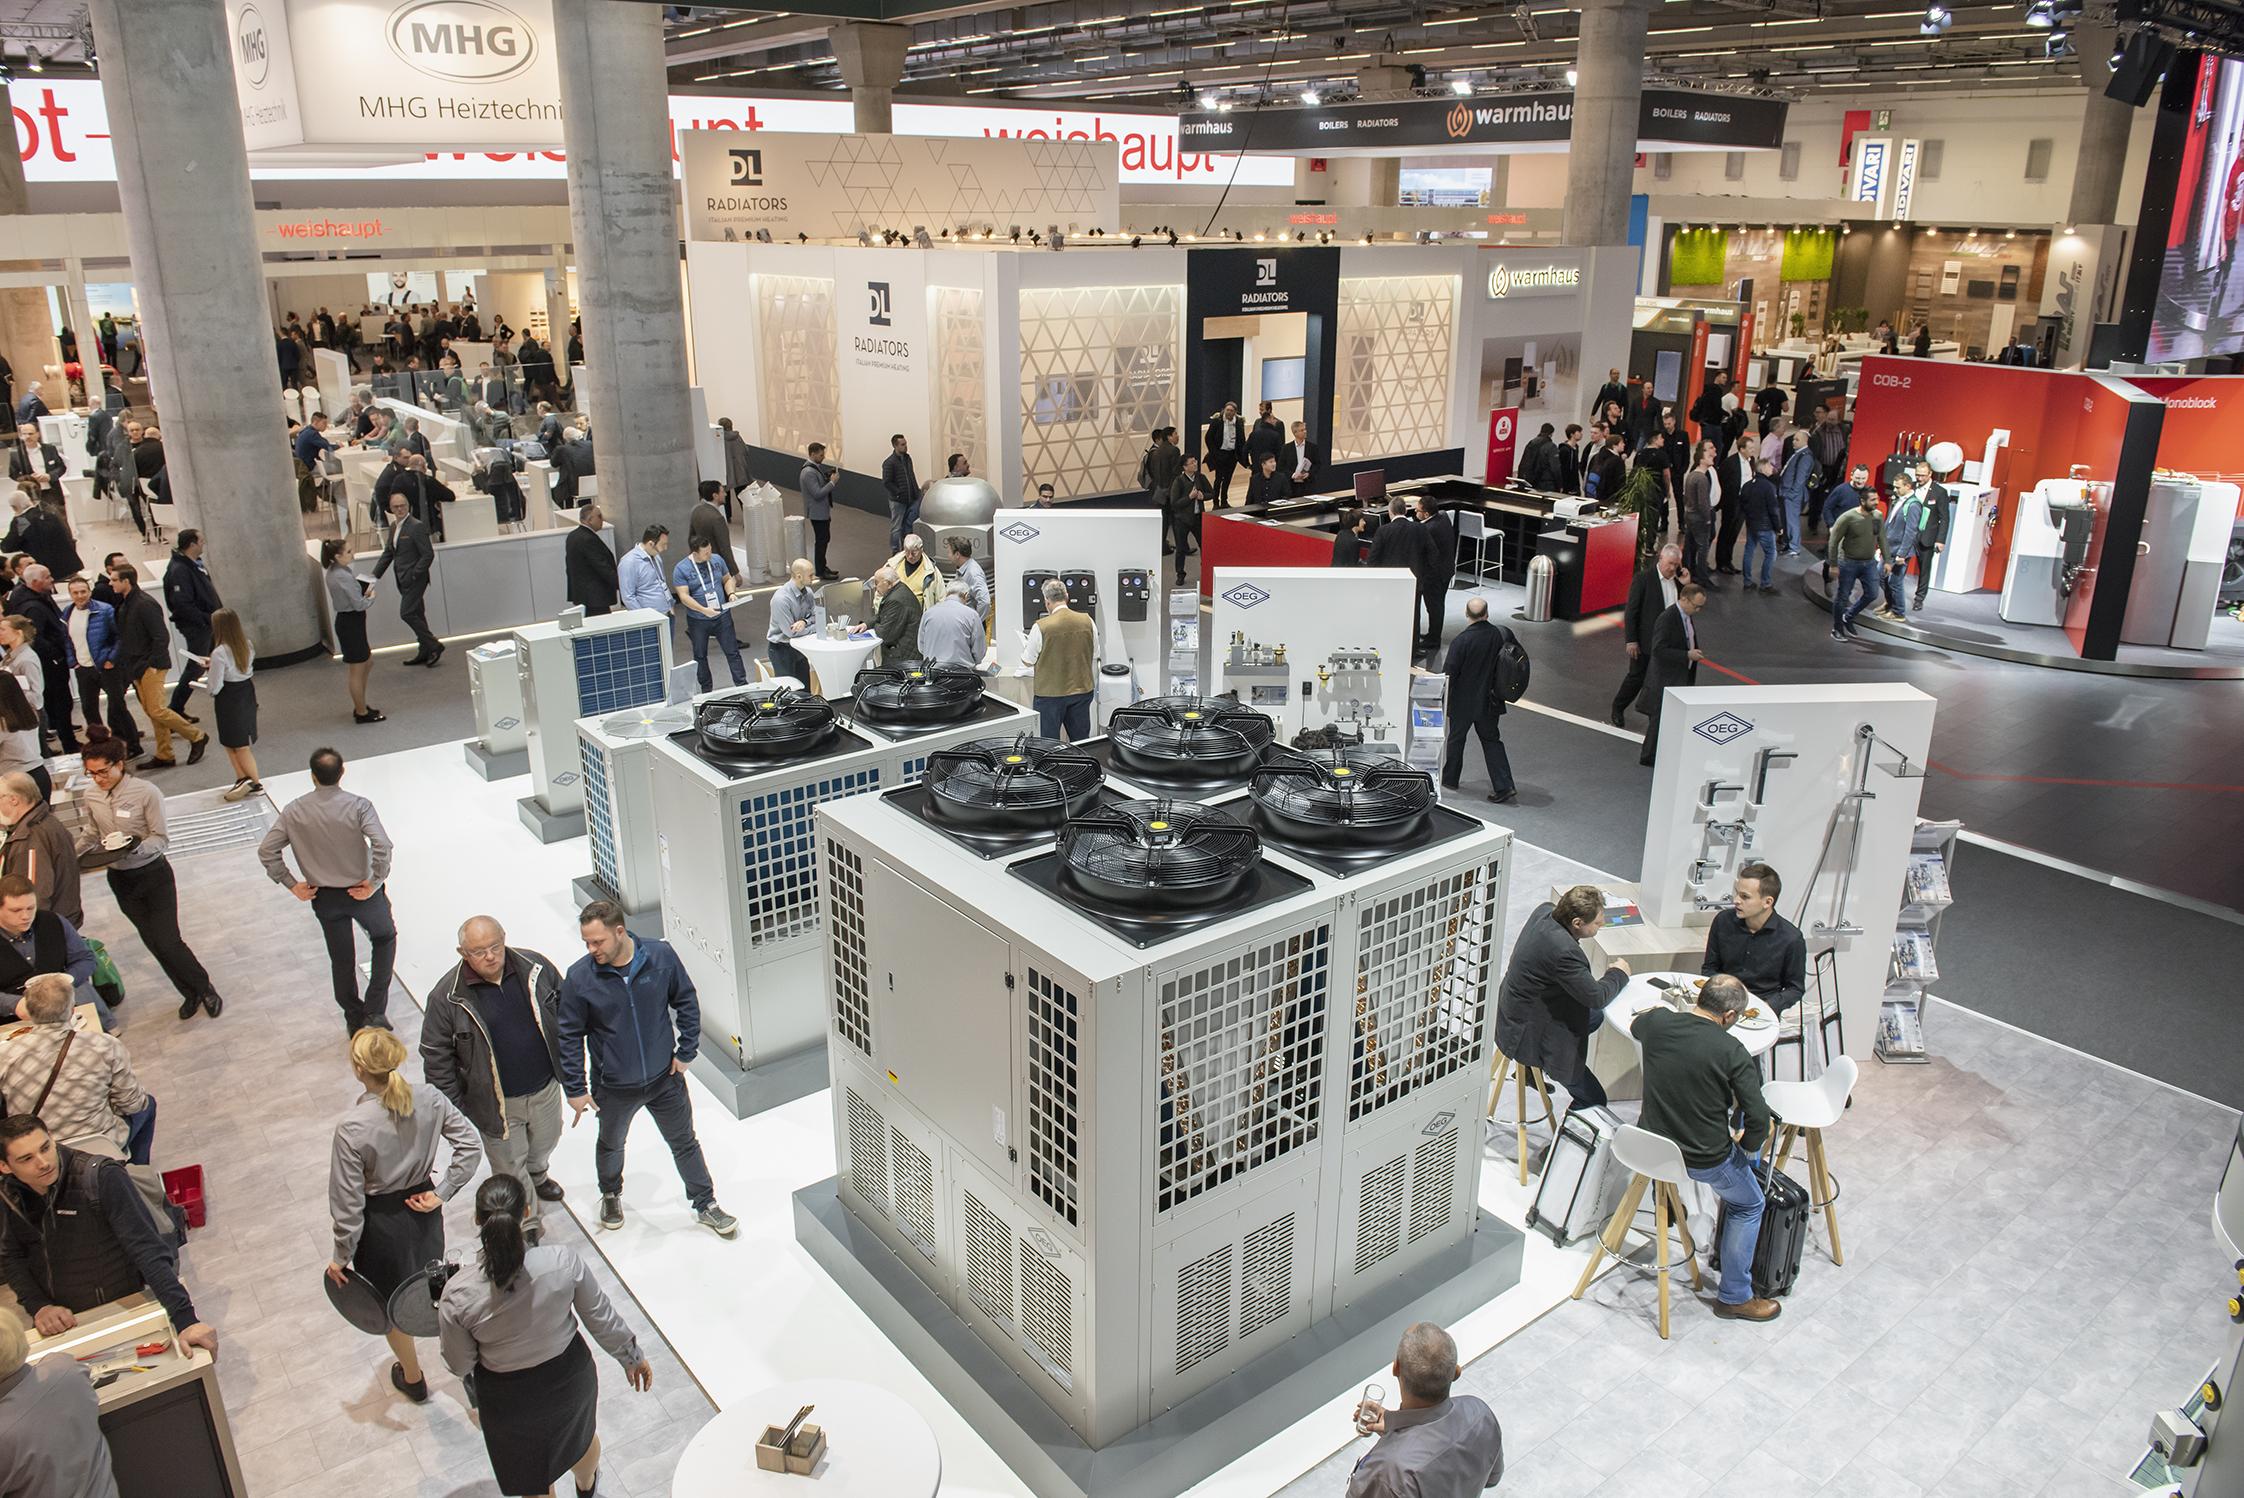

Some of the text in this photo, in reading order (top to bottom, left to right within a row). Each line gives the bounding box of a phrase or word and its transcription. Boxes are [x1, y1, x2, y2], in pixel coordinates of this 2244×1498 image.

[241, 28, 266, 64] MHG
[411, 23, 517, 57] MHG
[359, 96, 563, 120] MHG Heiztechni
[1652, 107, 1731, 123] BOILERS RADIATORS
[1318, 118, 1399, 131] BOILERS RADIATORS
[728, 149, 763, 186] DL
[707, 197, 788, 211] RADIATORS
[278, 218, 383, 239] weishaupt
[1256, 258, 1277, 286] DL
[1510, 265, 1580, 287] warmhaus
[867, 281, 891, 327] DL
[1241, 292, 1289, 304] RADIATORS
[854, 336, 909, 358] RADIATORS
[1873, 374, 1912, 389] COB-2
[1009, 529, 1030, 537] OEG
[1233, 592, 1258, 600] OEG
[1707, 723, 1738, 734] OEG
[1429, 1116, 1448, 1131] OEG
